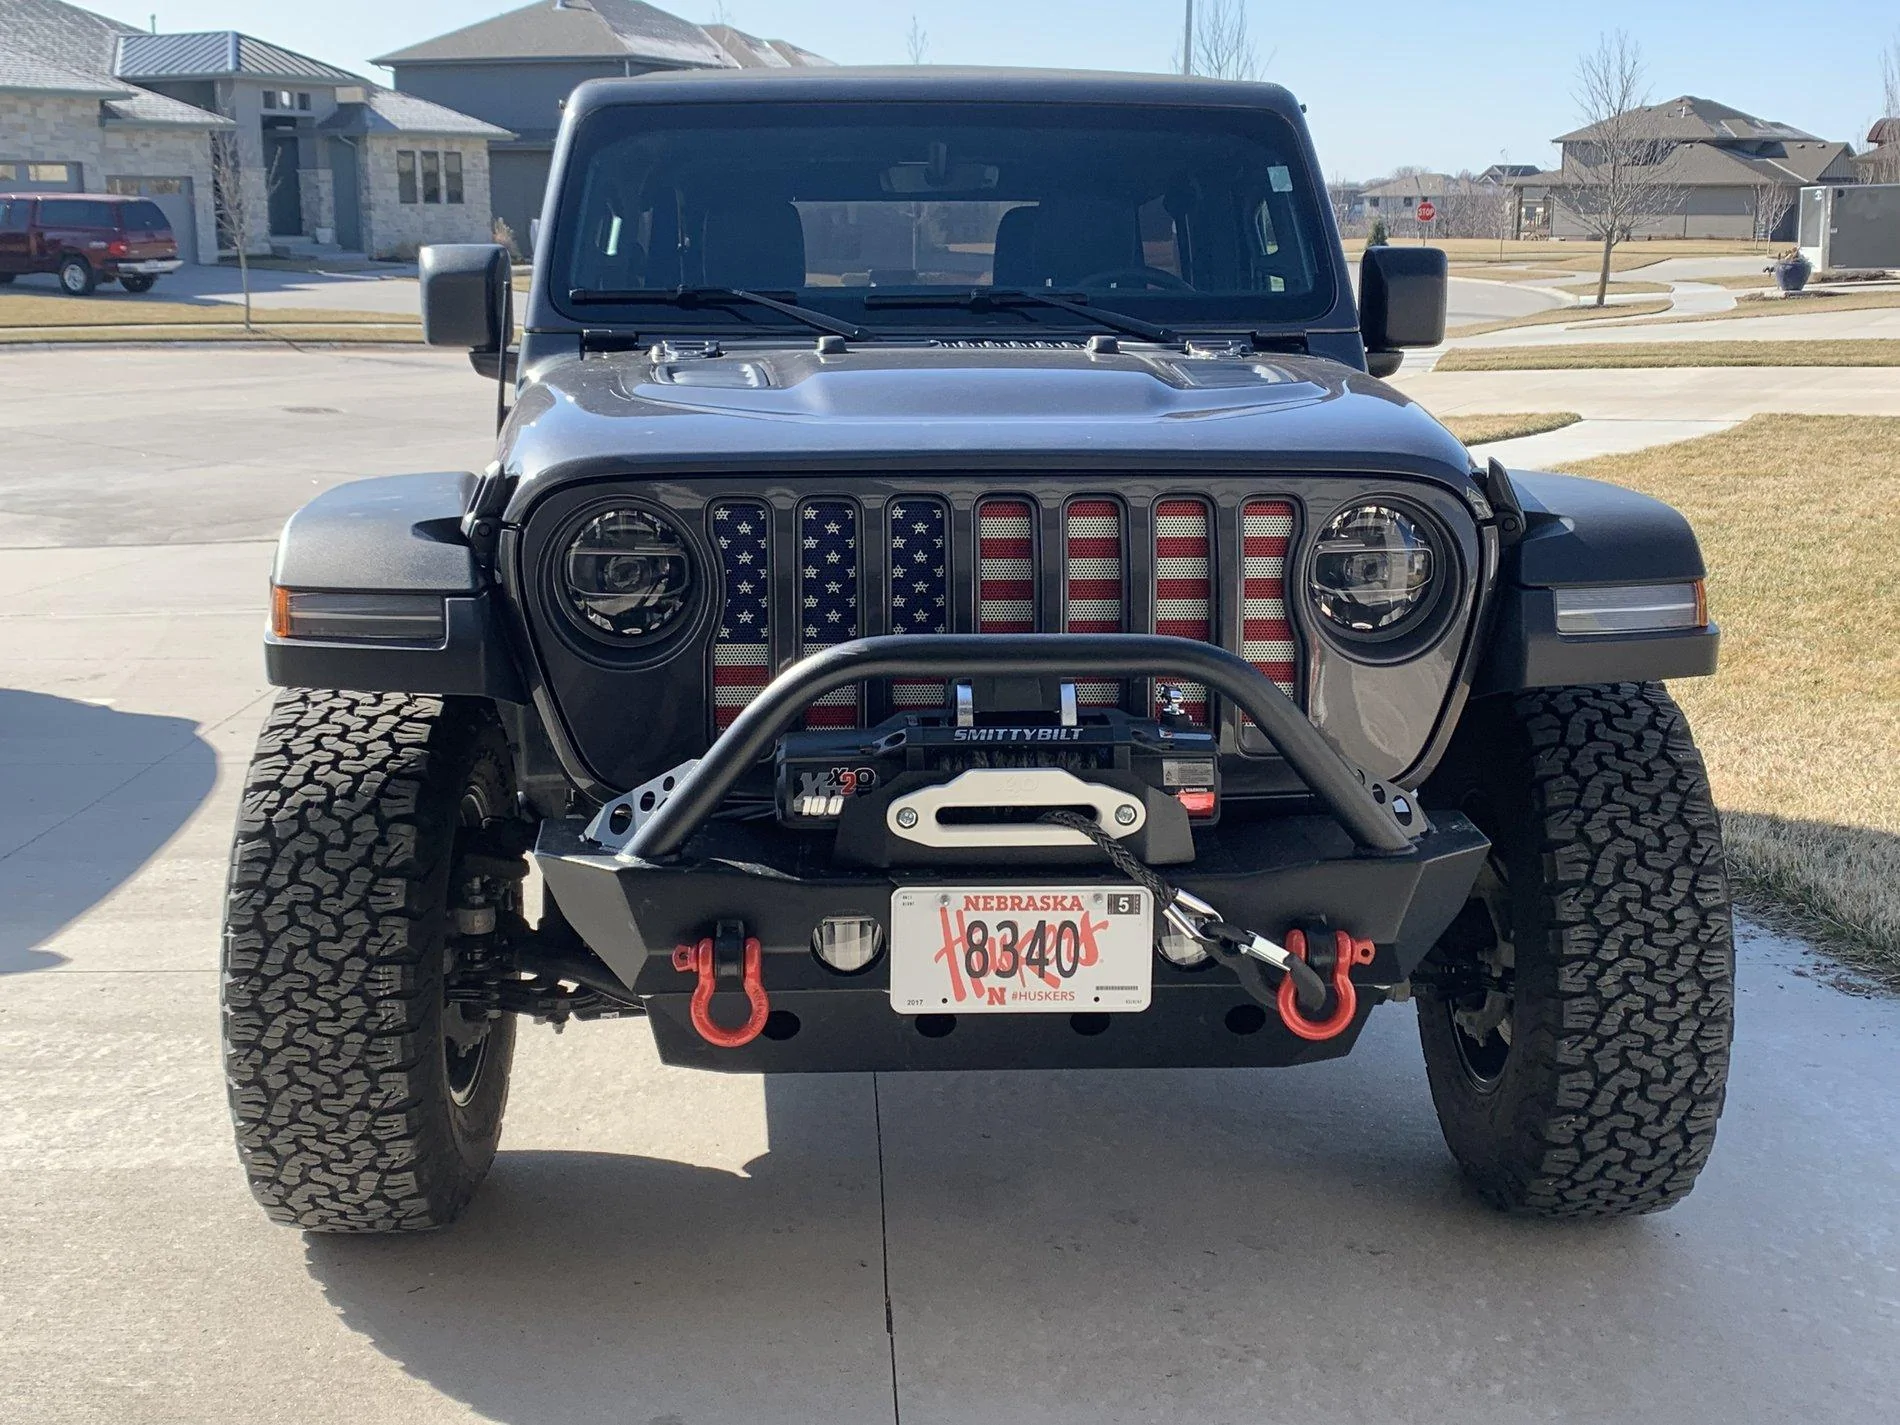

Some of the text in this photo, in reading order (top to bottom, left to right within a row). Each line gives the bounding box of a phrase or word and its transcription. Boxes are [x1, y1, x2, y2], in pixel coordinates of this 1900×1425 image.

[1418, 207, 1435, 217] STOP
[954, 728, 1083, 741] SMITTYBILT
[963, 895, 1085, 912] NEBRASKA
[1118, 897, 1130, 912] 5
[965, 920, 1080, 979] 8340
[987, 987, 1076, 1006] N #HUSKERS
